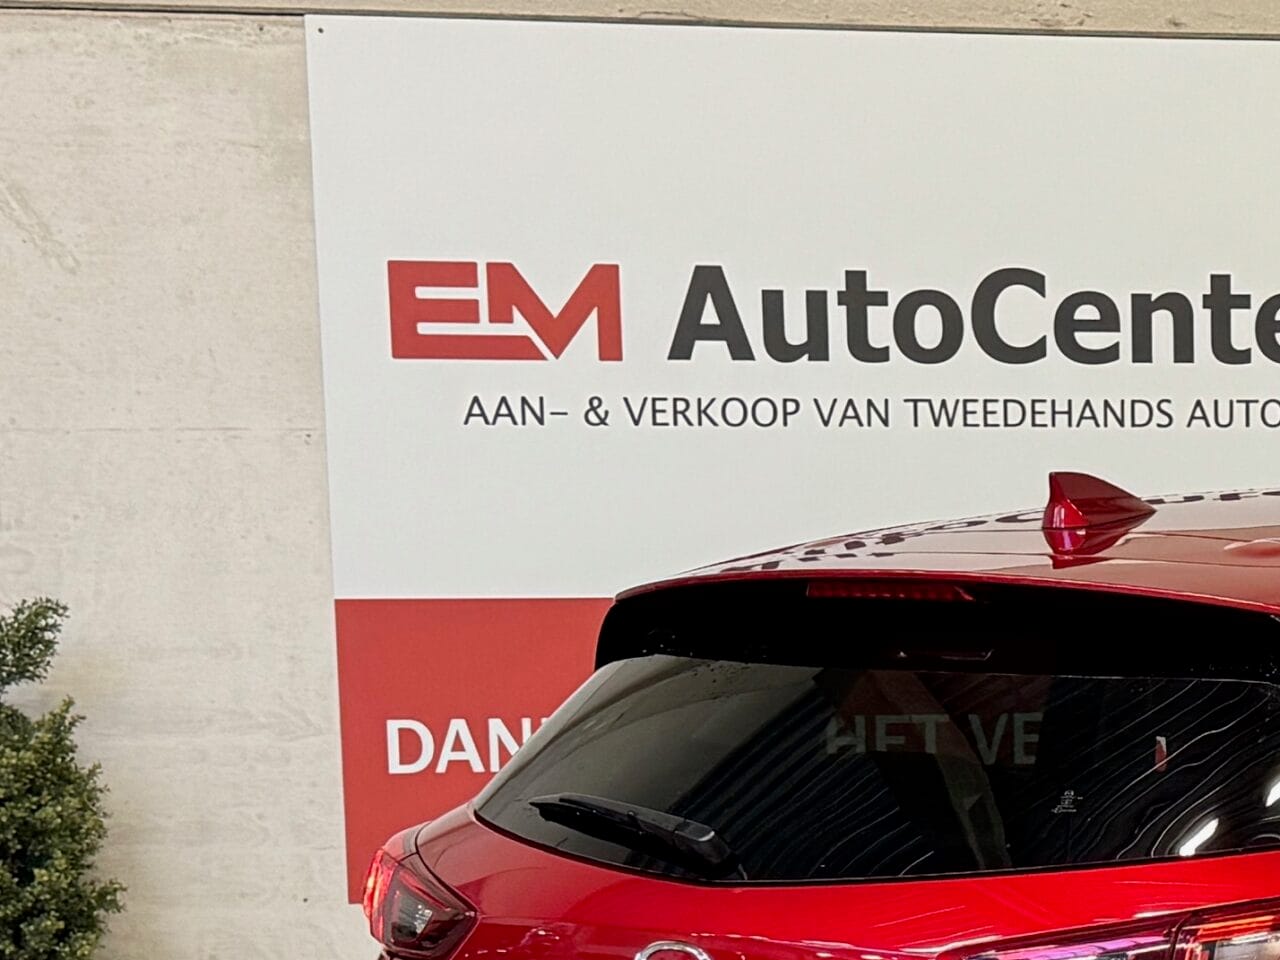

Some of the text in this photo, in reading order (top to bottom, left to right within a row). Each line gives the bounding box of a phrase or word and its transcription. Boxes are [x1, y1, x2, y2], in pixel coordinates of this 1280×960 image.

[387, 259, 623, 362] EM
[583, 396, 609, 426] &
[623, 396, 801, 427] VERKOOP
[813, 398, 891, 427] VAN
[903, 398, 1174, 428] TWEEDEHANDS
[386, 717, 550, 775] DAN
